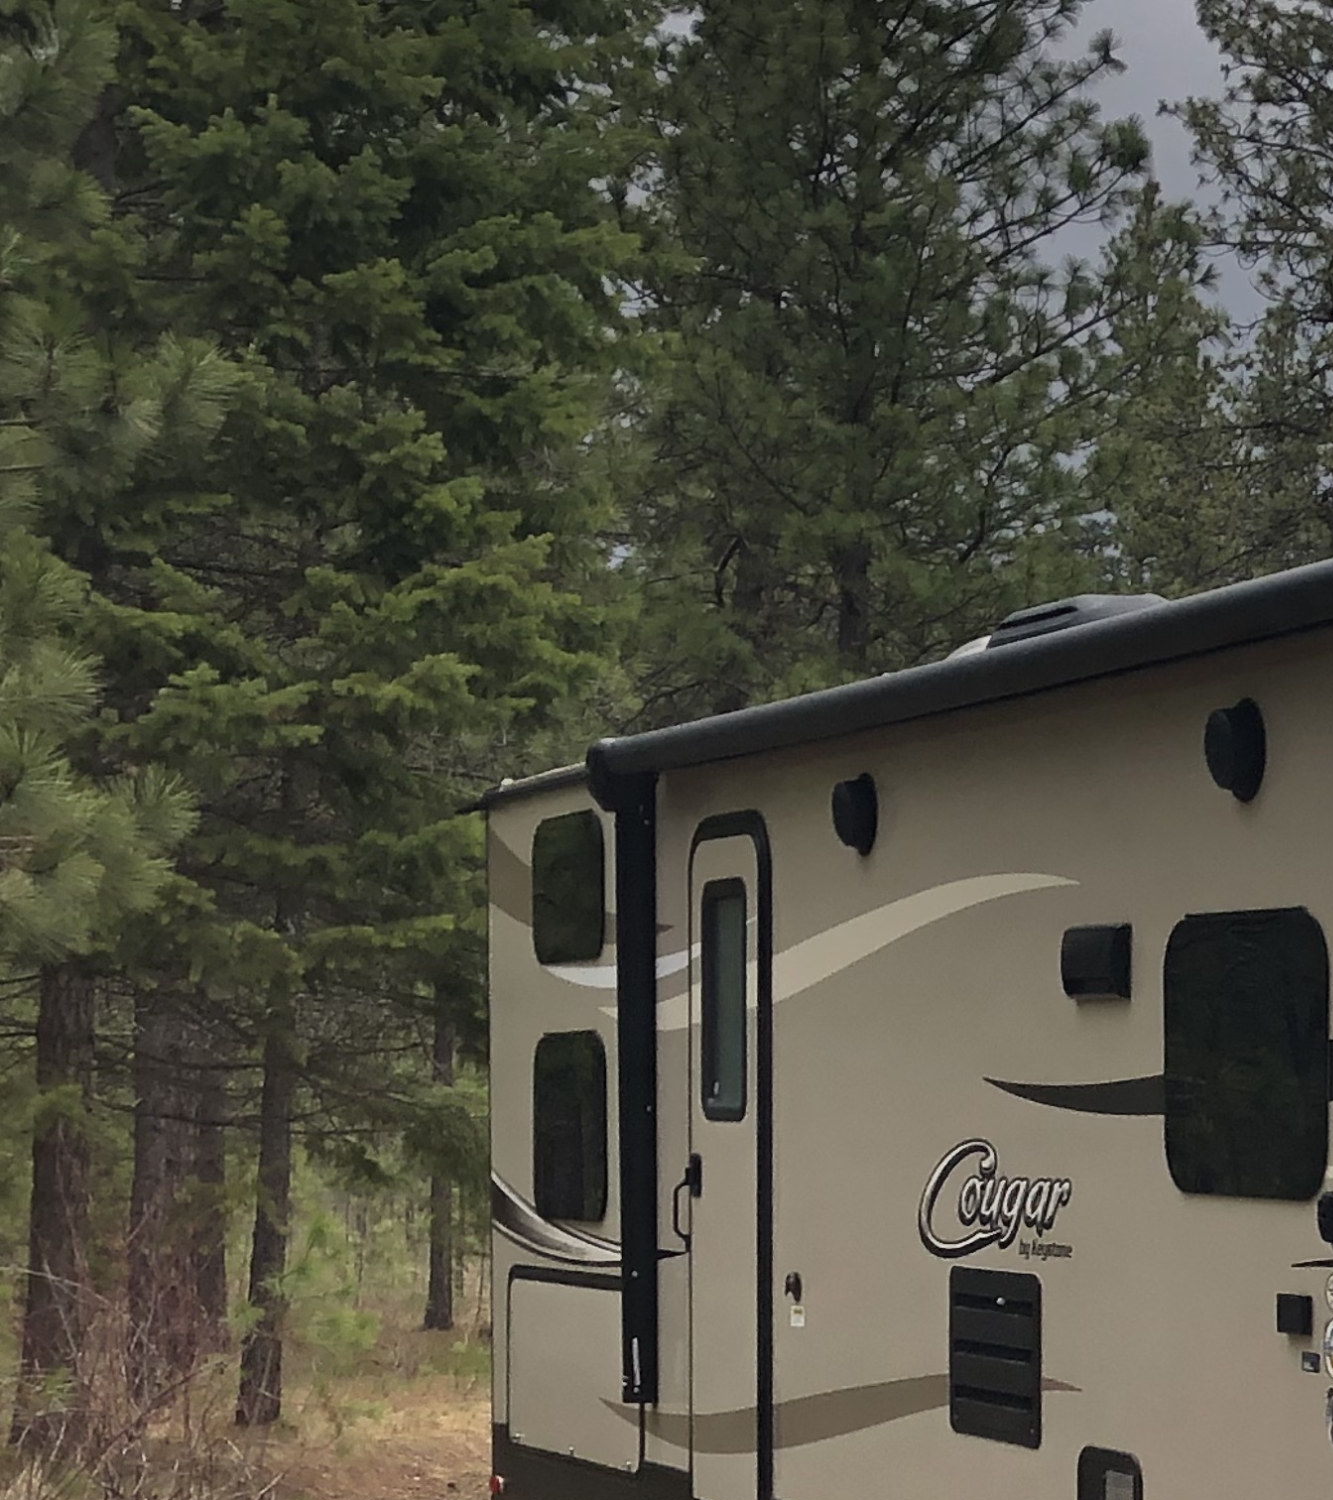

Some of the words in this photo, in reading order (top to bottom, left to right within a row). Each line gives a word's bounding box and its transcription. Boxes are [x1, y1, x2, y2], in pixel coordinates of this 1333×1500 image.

[918, 1138, 1071, 1258] Cougar
[1019, 1238, 1030, 1260] by
[1031, 1239, 1073, 1261] Keystone
